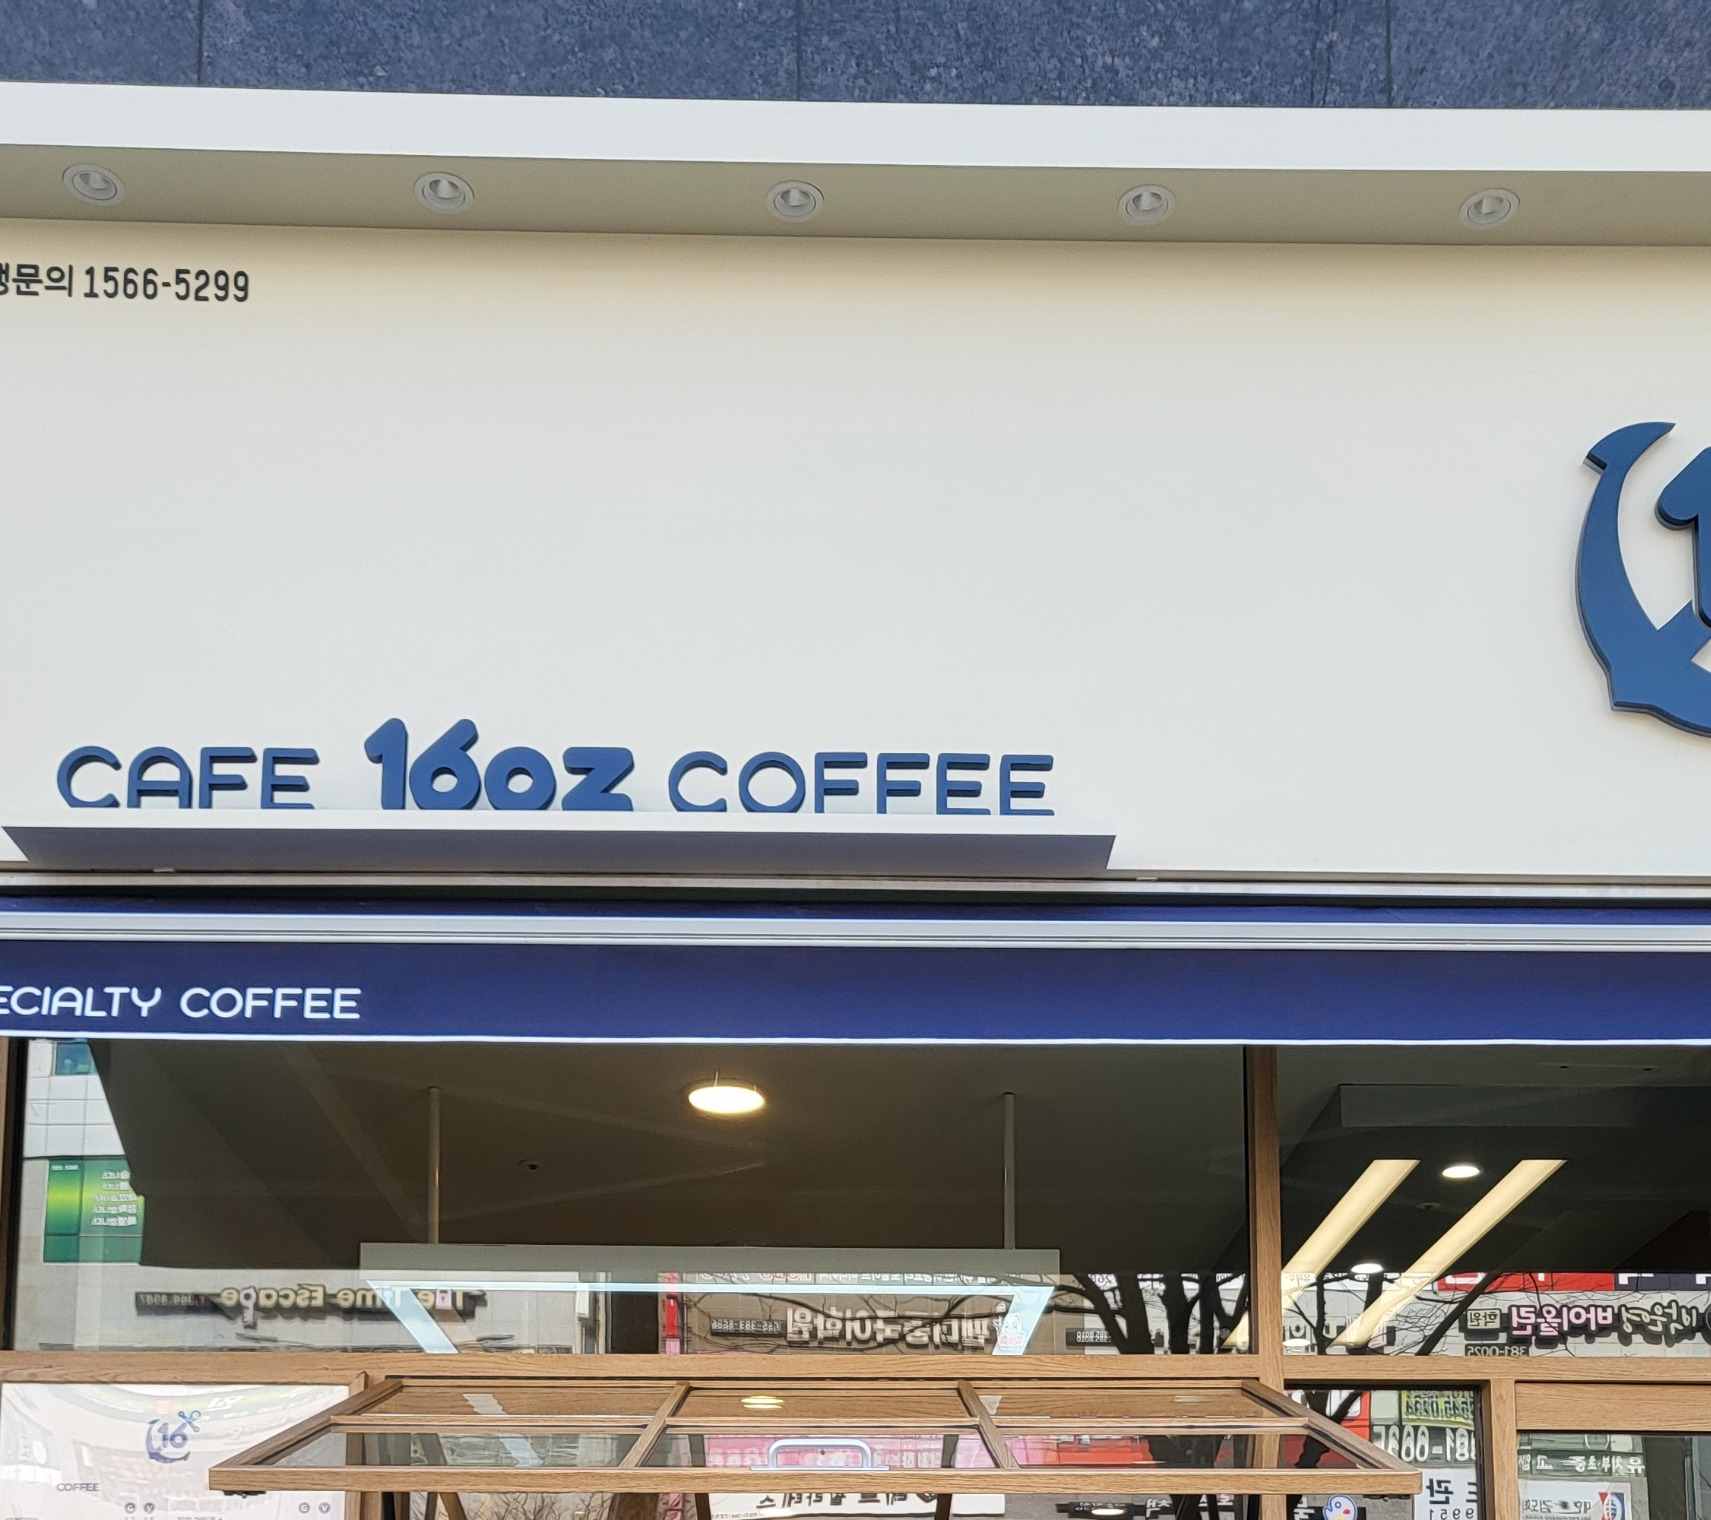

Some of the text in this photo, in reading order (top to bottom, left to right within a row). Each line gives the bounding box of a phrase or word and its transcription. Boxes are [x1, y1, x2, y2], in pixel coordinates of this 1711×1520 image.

[84, 265, 250, 303] 1566-5299
[56, 717, 1056, 817] CAFE 16oz COFFEE
[178, 986, 362, 1020] COFFEE
[56, 1482, 100, 1492] COFFEE
